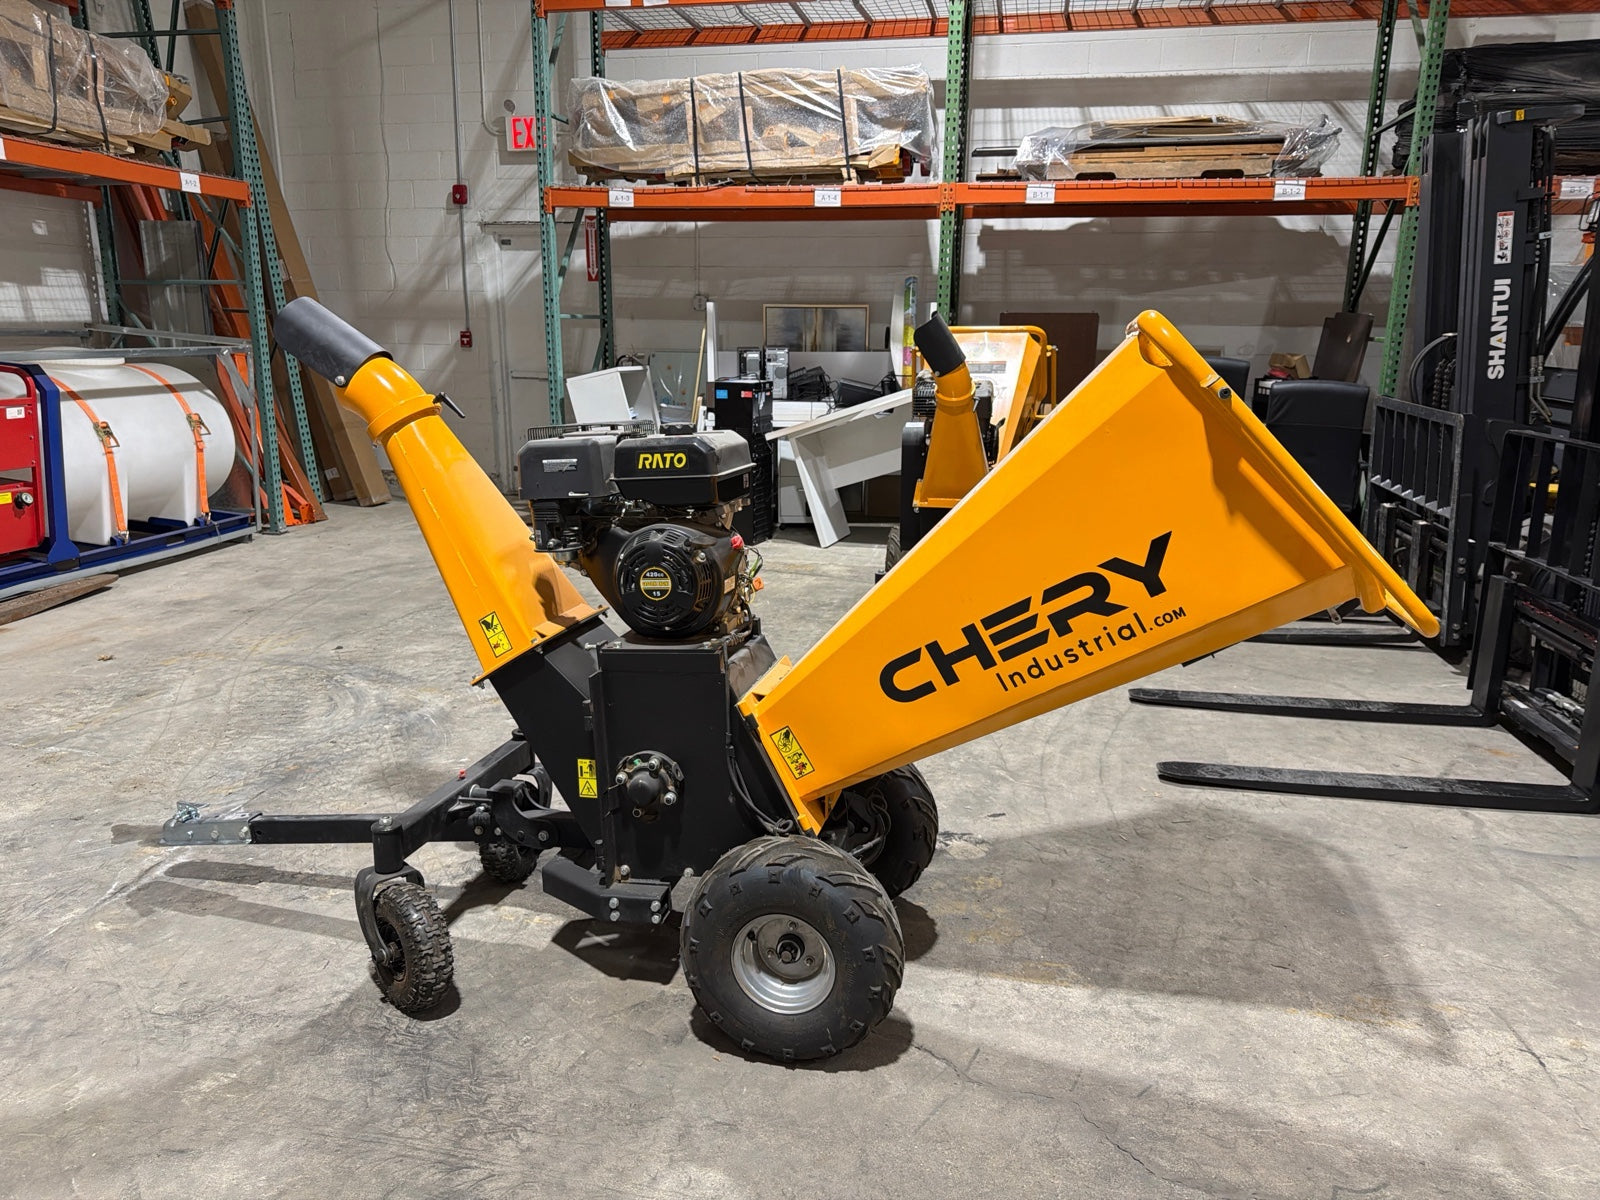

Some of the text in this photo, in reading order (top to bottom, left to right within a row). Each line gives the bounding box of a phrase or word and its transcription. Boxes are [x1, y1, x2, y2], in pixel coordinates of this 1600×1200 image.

[1487, 278, 1511, 380] SHANTUI
[638, 453, 687, 469] RATO
[879, 530, 1172, 703] CHERY
